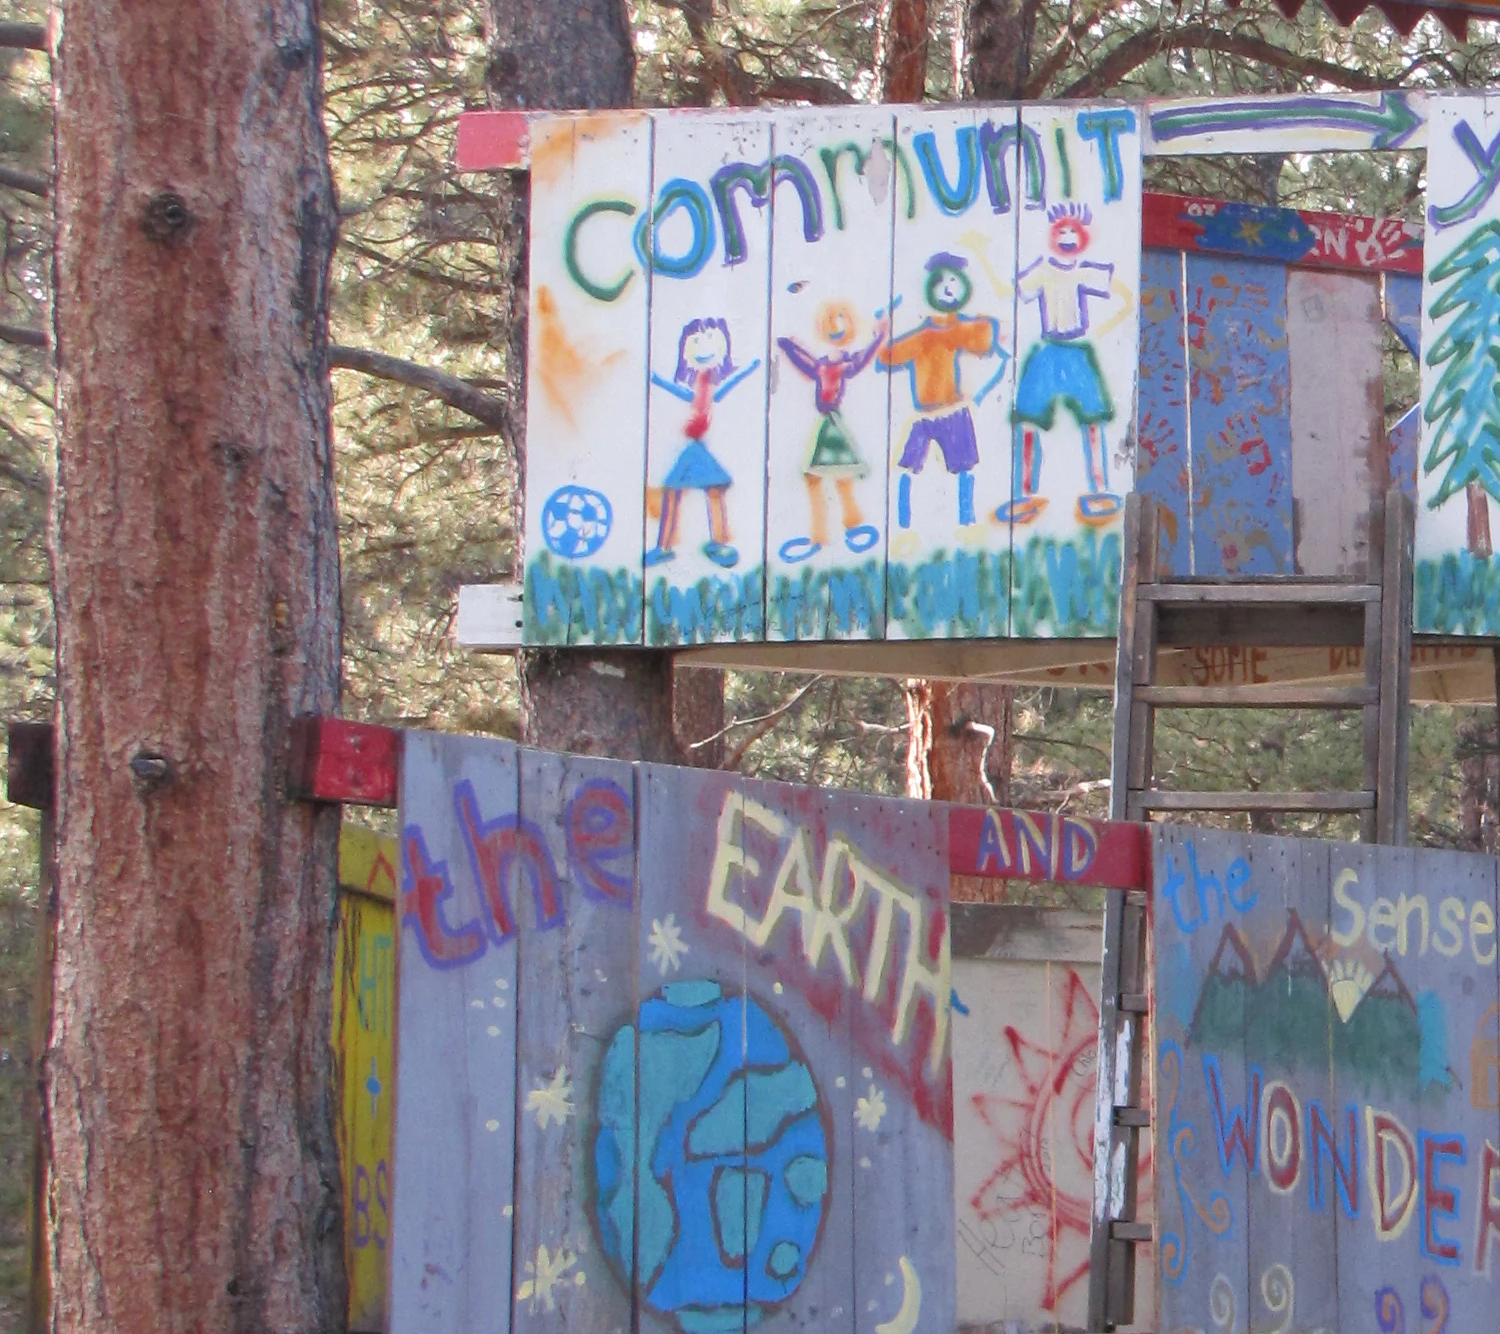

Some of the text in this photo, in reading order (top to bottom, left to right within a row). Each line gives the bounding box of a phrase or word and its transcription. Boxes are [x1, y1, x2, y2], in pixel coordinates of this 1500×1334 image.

[400, 777, 640, 969] the
[706, 789, 953, 1076] EARTH
[976, 809, 1098, 880] AND
[1161, 839, 1259, 935] the
[1329, 866, 1498, 966] Sense
